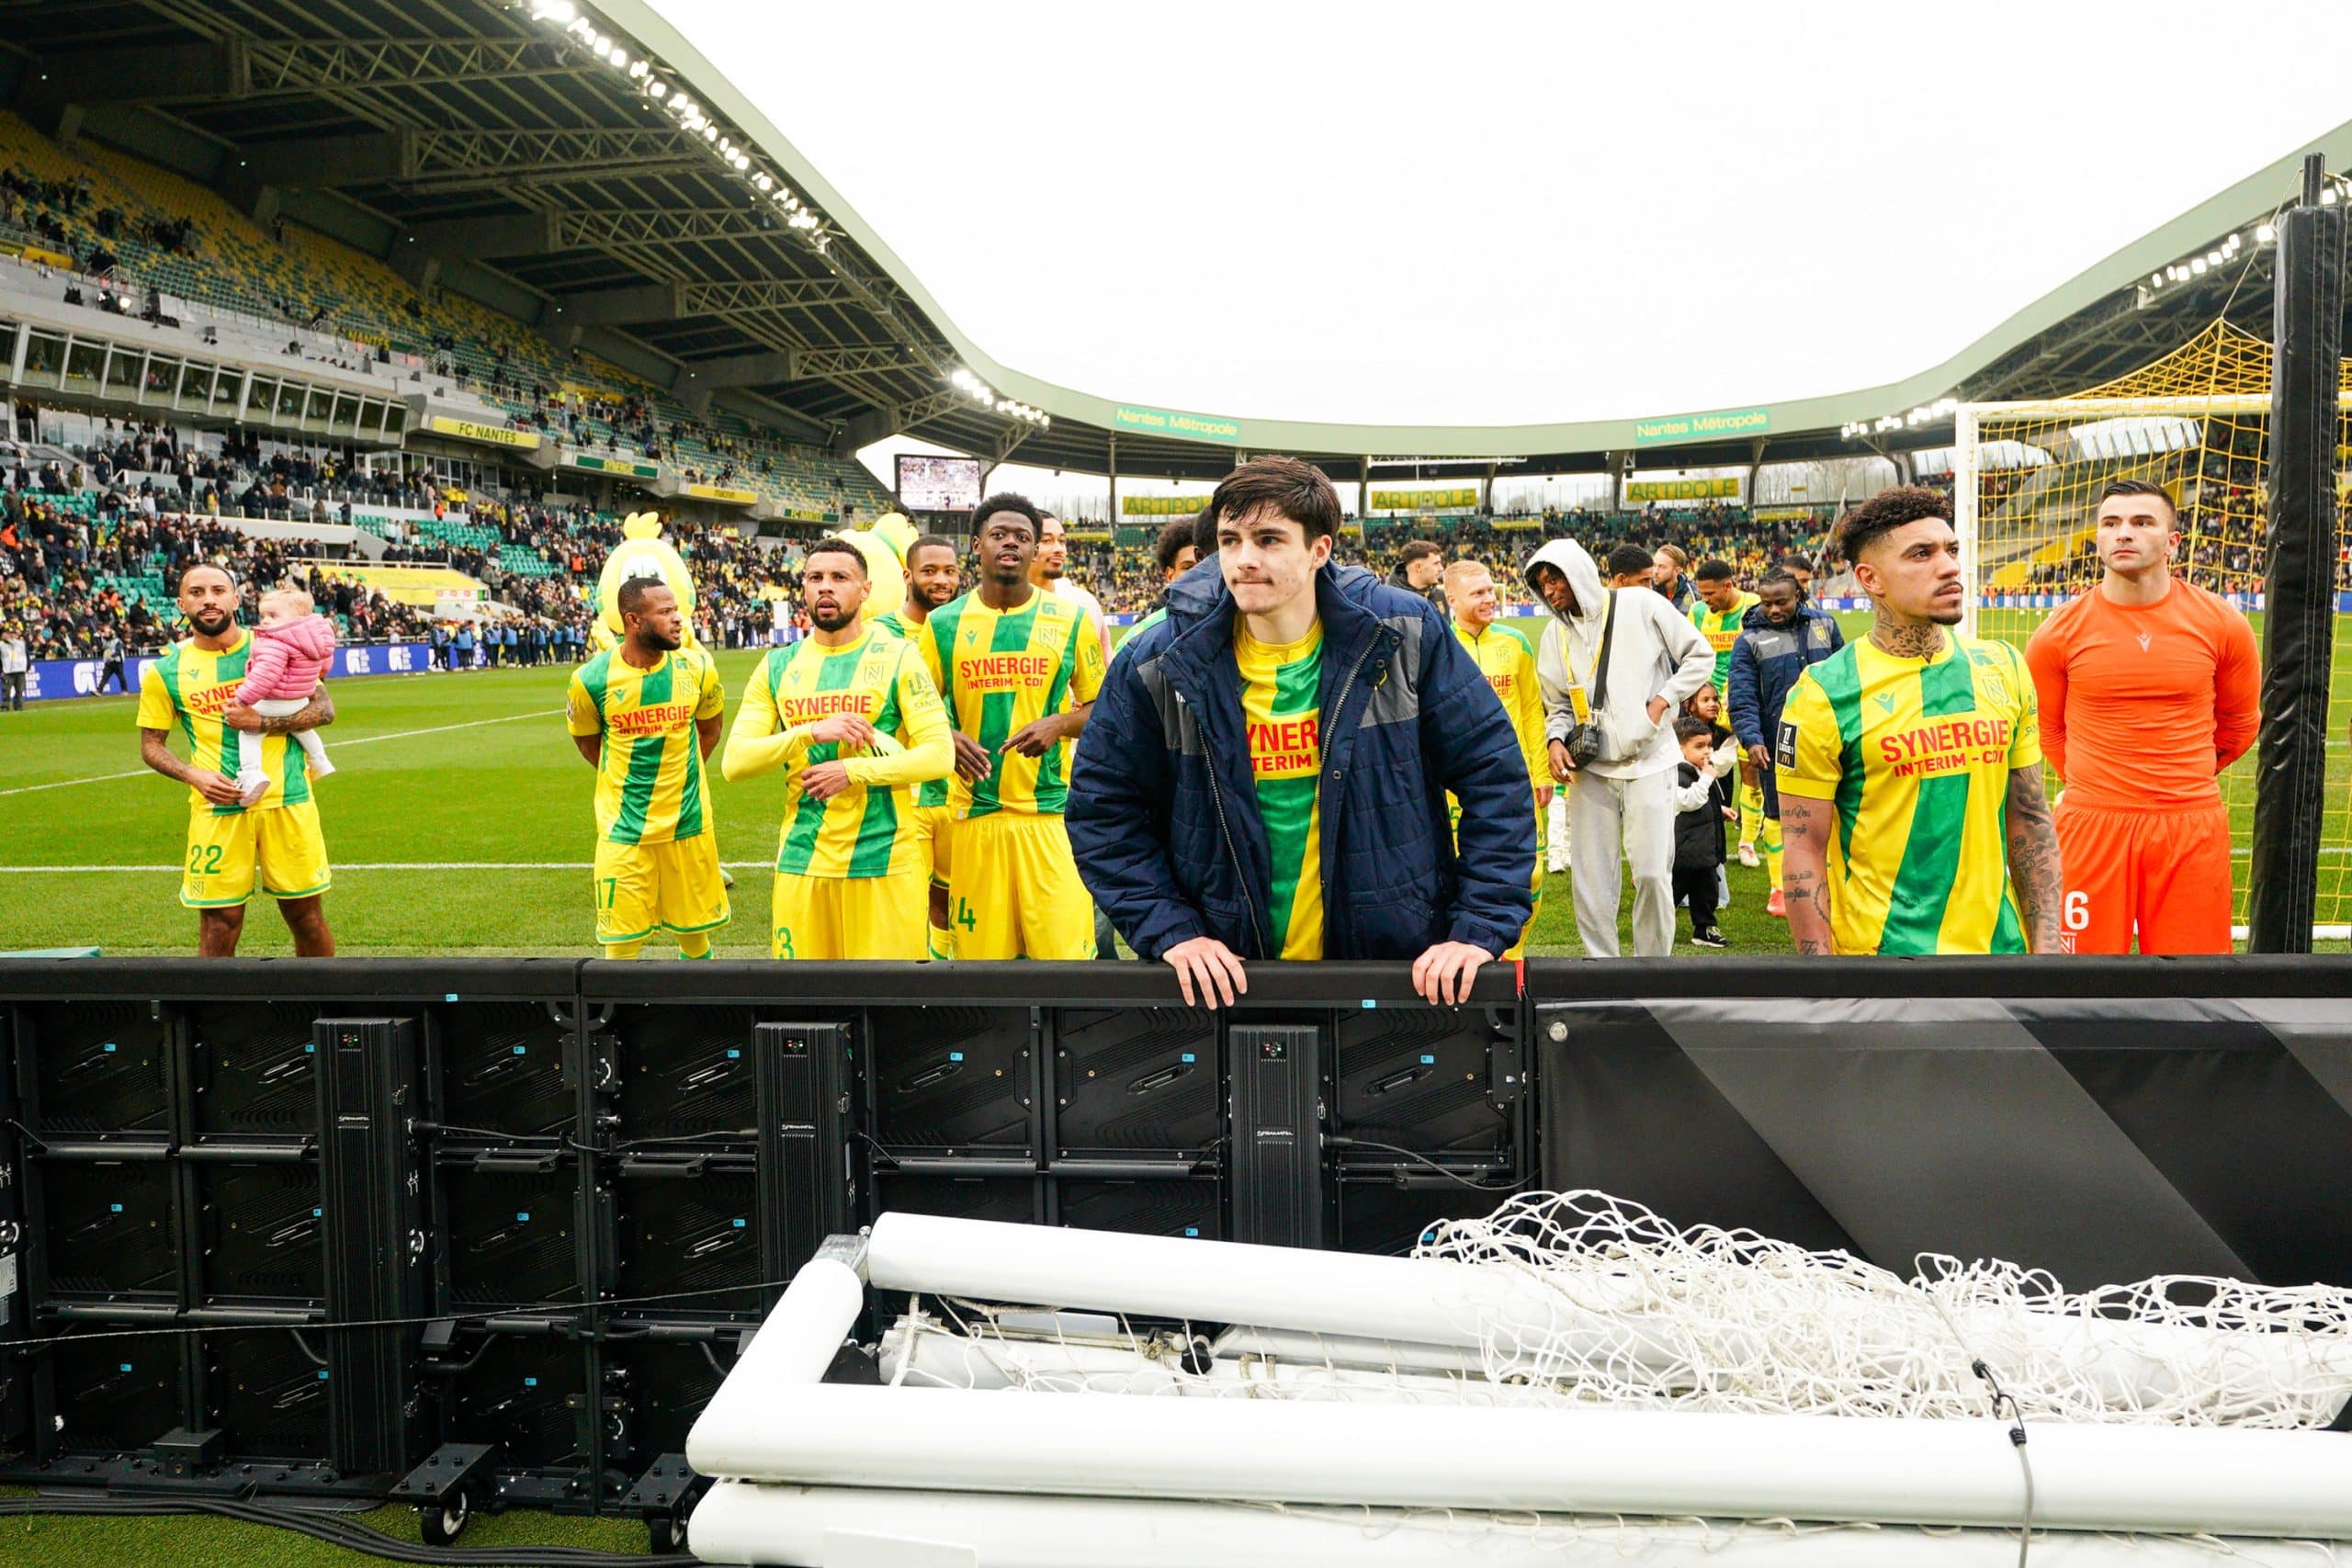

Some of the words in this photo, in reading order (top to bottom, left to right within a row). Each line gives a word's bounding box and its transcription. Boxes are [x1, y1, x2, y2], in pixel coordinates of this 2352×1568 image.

[1117, 408, 1166, 427] Nantes
[458, 423, 473, 435] FC
[476, 426, 516, 443] NANTES
[1636, 423, 1690, 437] Nantes
[1374, 488, 1475, 509] ARTIPOLE
[1630, 479, 1738, 501] ARTIPOLE
[960, 657, 1049, 678] SYNERGIE
[967, 677, 1013, 690] INTERIM
[1024, 677, 1043, 687] CDI
[612, 705, 690, 728] SYNERGIE
[785, 694, 872, 718] SYNERGIE
[1880, 719, 2008, 763] SYNERGIE
[1894, 752, 1967, 777] INTERIM
[1983, 750, 2004, 764] CDI
[189, 844, 222, 874] 22
[596, 877, 616, 909] 17
[949, 896, 977, 933] 24
